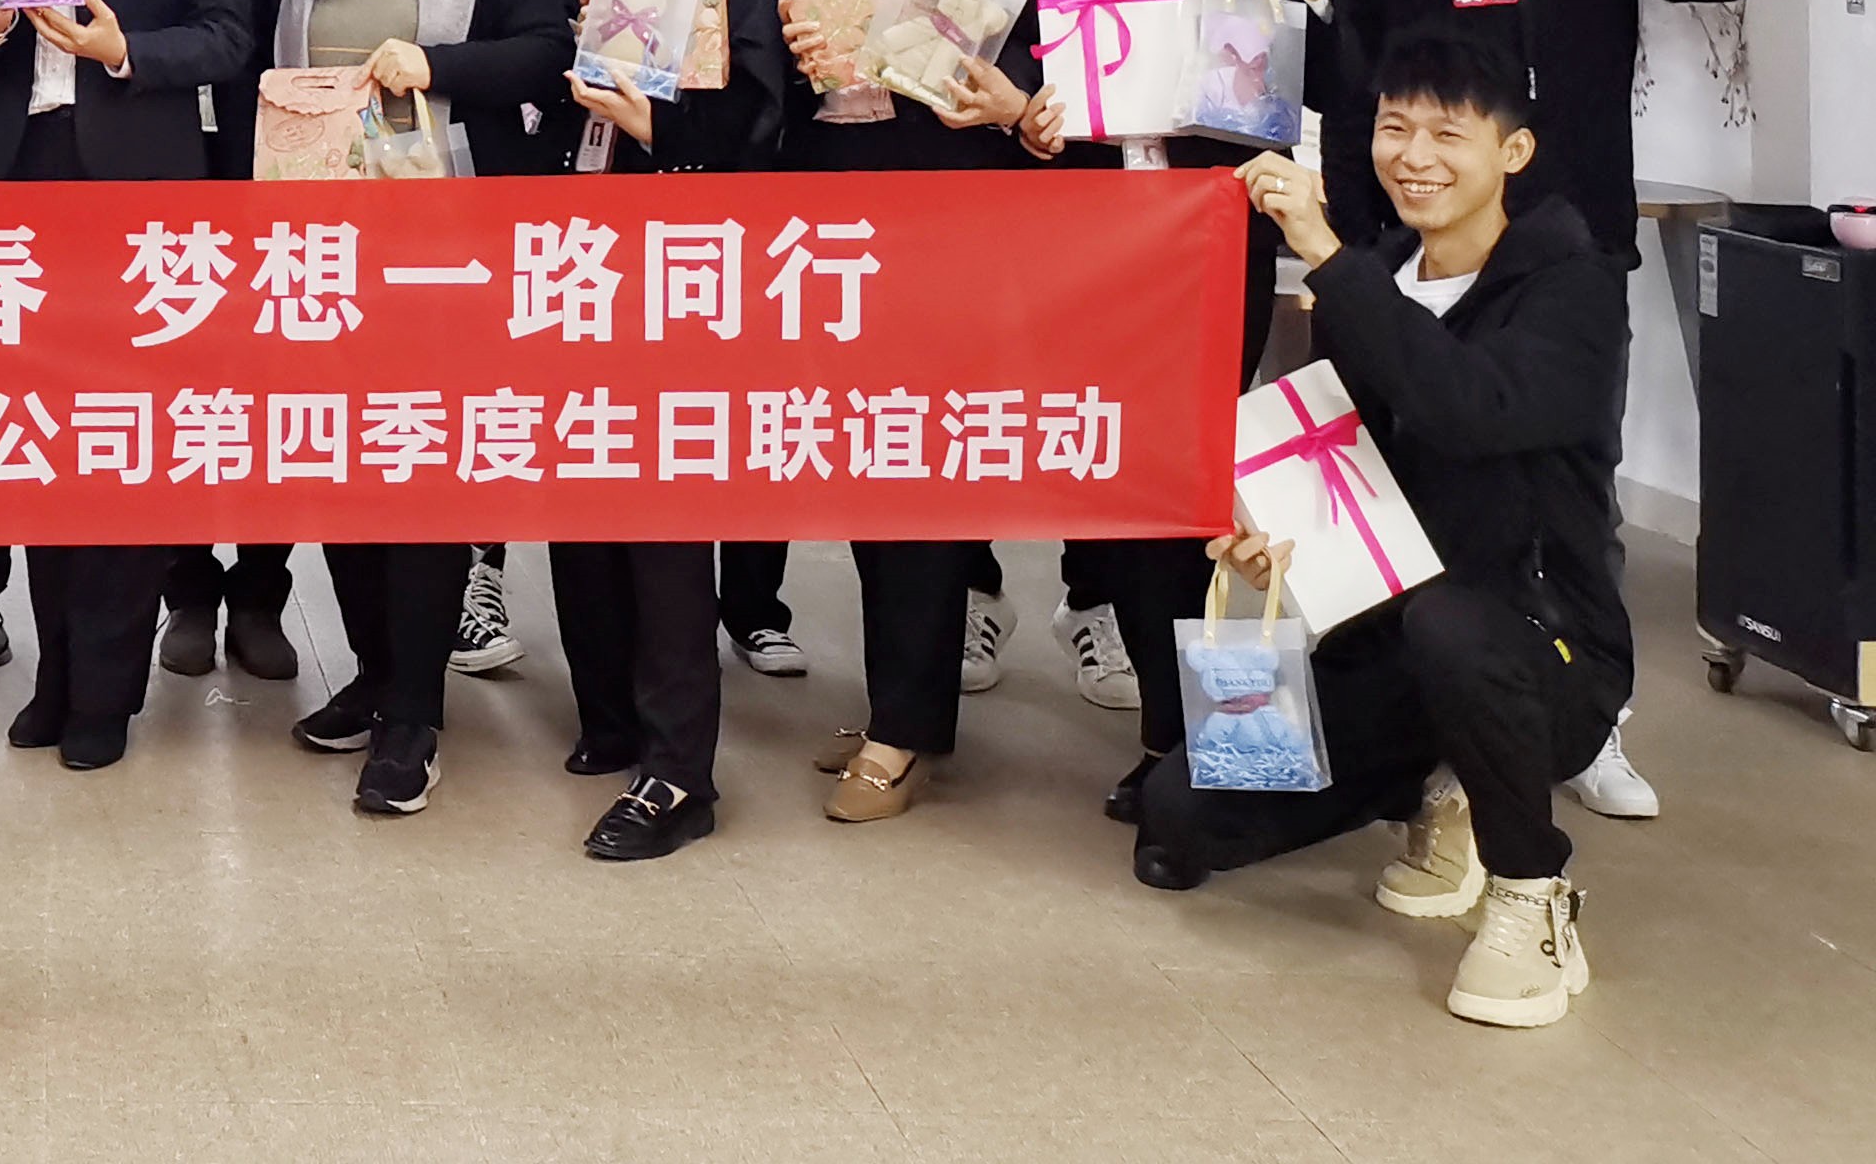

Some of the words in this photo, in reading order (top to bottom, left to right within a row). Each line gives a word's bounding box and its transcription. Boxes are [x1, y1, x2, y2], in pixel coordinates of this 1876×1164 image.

[121, 217, 880, 347] 梦想一路同行
